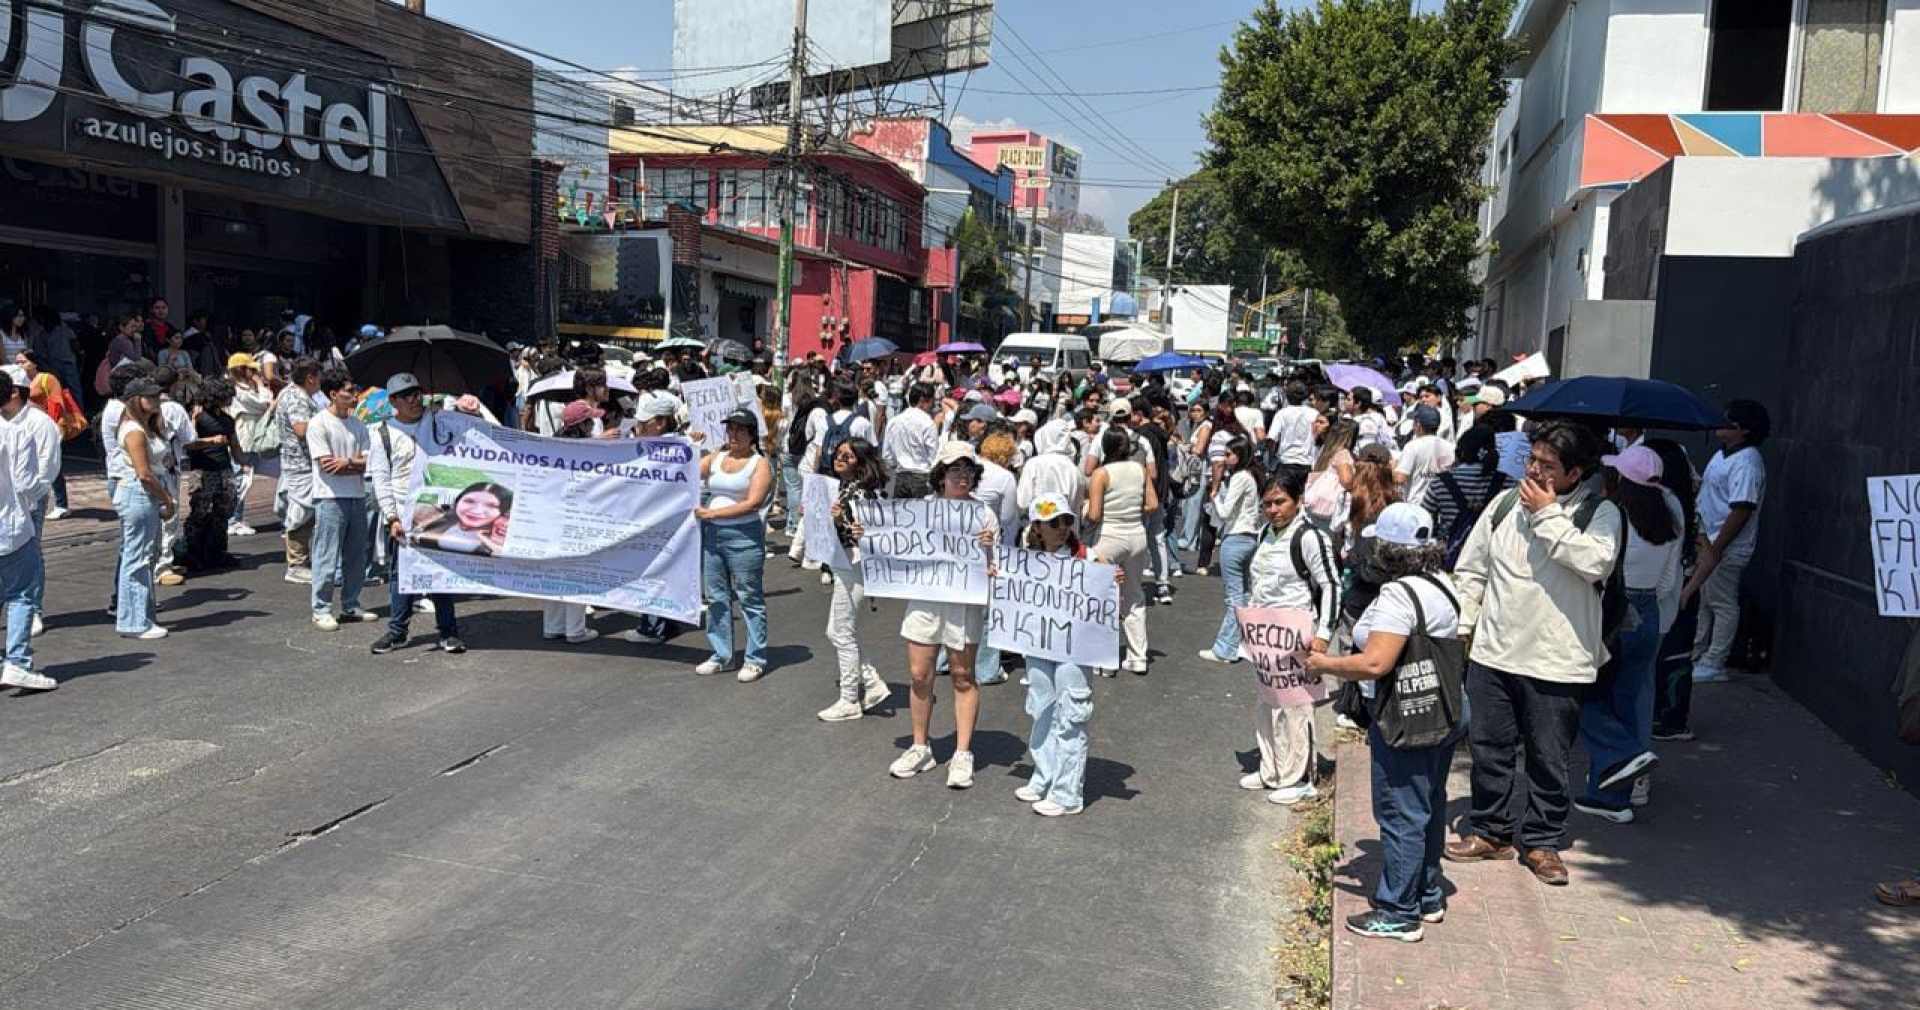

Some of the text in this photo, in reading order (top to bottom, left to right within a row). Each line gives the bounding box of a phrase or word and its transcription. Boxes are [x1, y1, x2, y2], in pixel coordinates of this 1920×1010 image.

[80, 0, 387, 178] Castel
[84, 117, 292, 178] azulejos baños
[442, 445, 688, 483] AYÚDANOS A LOCALIZARLA
[860, 499, 885, 527] NO
[867, 532, 981, 560] TODAS NOS
[997, 545, 1090, 596] HASTA
[992, 577, 1120, 632] ENCONTRAR
[990, 609, 1072, 655] A KIM
[1276, 654, 1302, 671] LA
